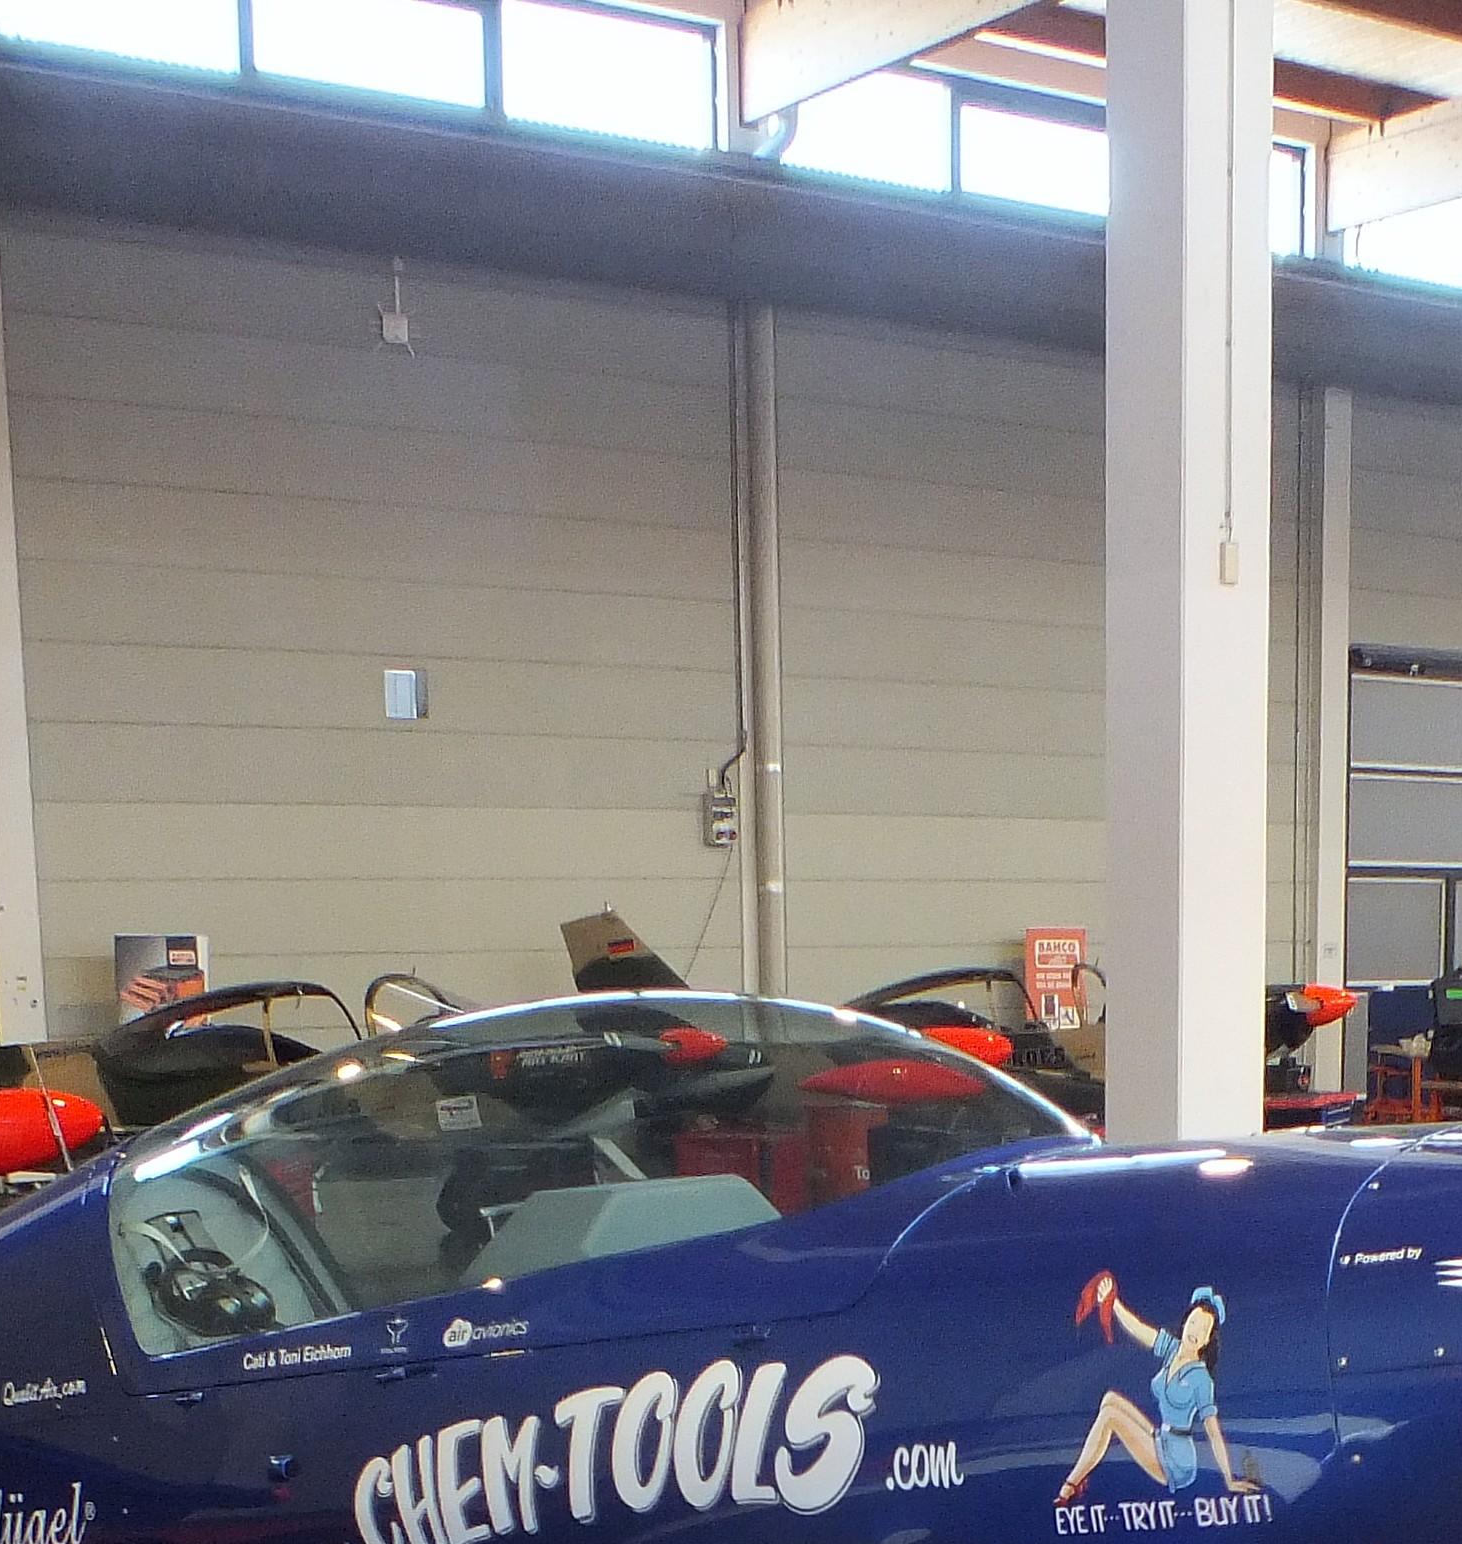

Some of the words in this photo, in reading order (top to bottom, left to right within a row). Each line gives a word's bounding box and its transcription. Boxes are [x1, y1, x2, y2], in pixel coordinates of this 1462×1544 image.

[1038, 942, 1076, 953] BAHCO
[1354, 1248, 1406, 1265] Powered
[1406, 1246, 1423, 1260] by
[885, 1443, 965, 1493] .com
[1055, 1506, 1089, 1535] EYE
[1194, 1496, 1239, 1527] BUY
